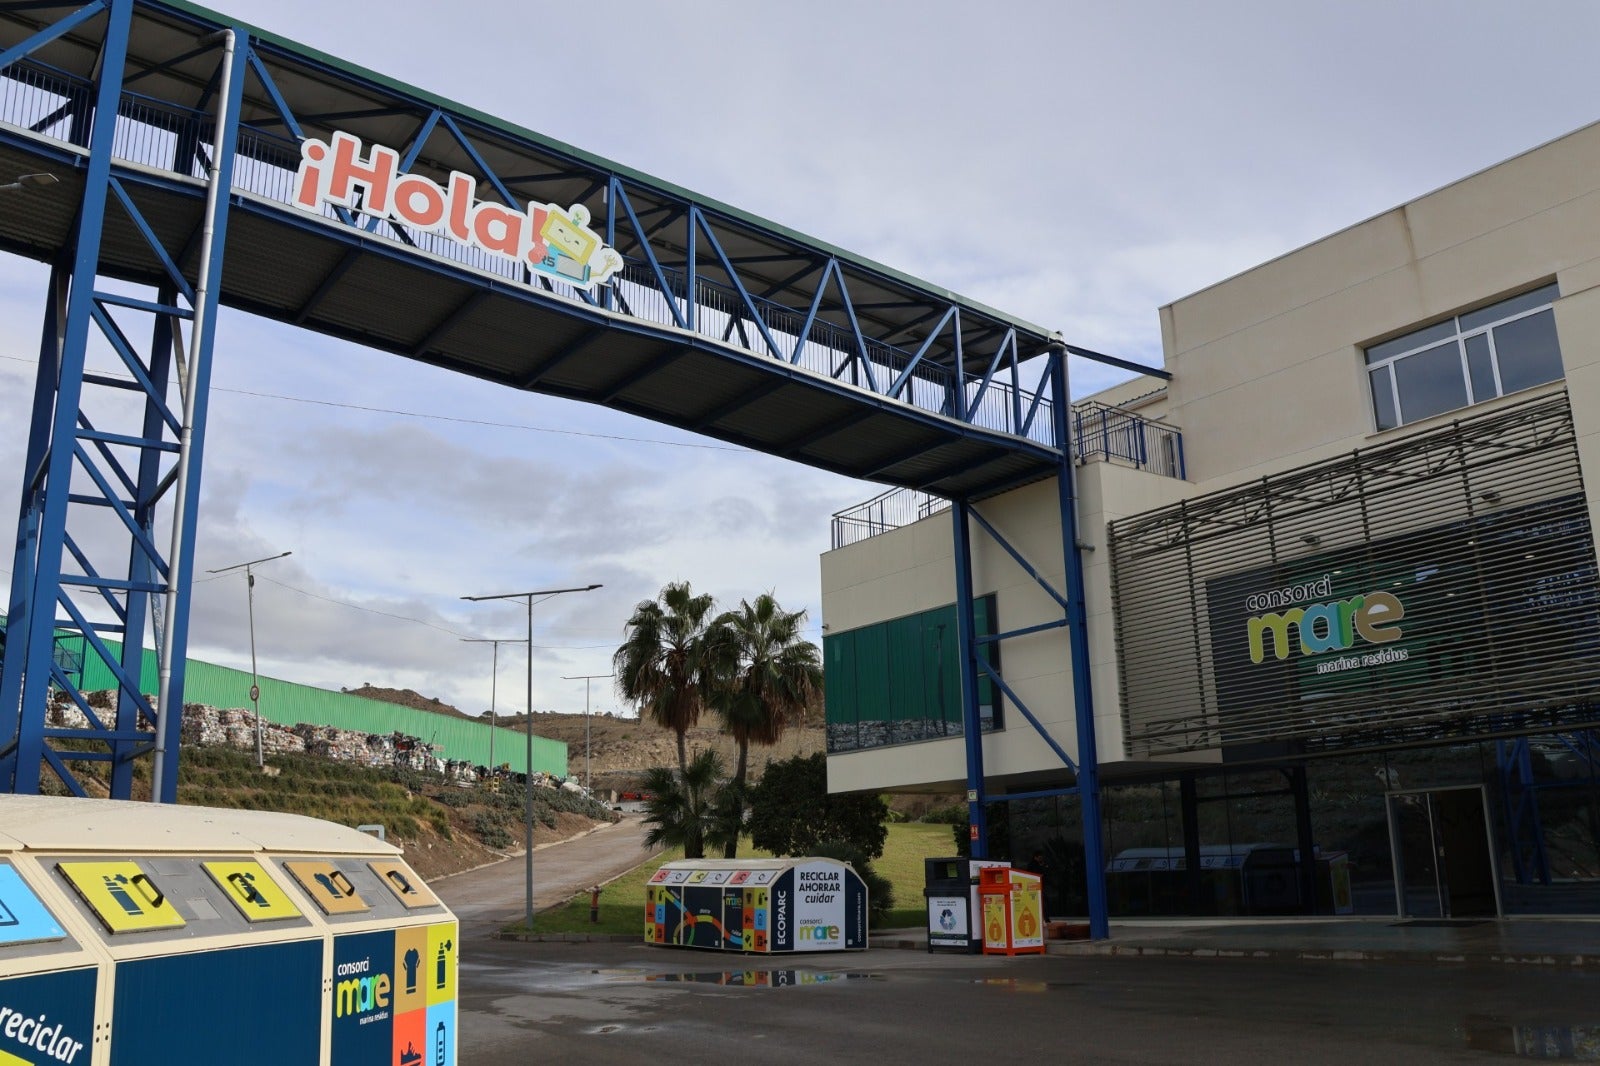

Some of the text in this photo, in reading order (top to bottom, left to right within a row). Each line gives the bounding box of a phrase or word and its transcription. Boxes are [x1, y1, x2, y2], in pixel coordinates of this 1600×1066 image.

[295, 133, 549, 266] ¡Hola!
[1246, 574, 1332, 612] consorci
[1247, 591, 1404, 664] mare
[1317, 648, 1409, 675] marina residus
[799, 883, 840, 892] AHORRAR
[800, 872, 839, 881] RECICLAR
[805, 893, 835, 904] cuidar
[777, 890, 787, 945] ECOPARC
[799, 917, 823, 925] consorci
[799, 925, 840, 940] mare
[337, 956, 370, 976] consorci
[336, 973, 391, 1018] mare
[359, 1015, 374, 1025] marina
[0, 1006, 83, 1065] reciclar
